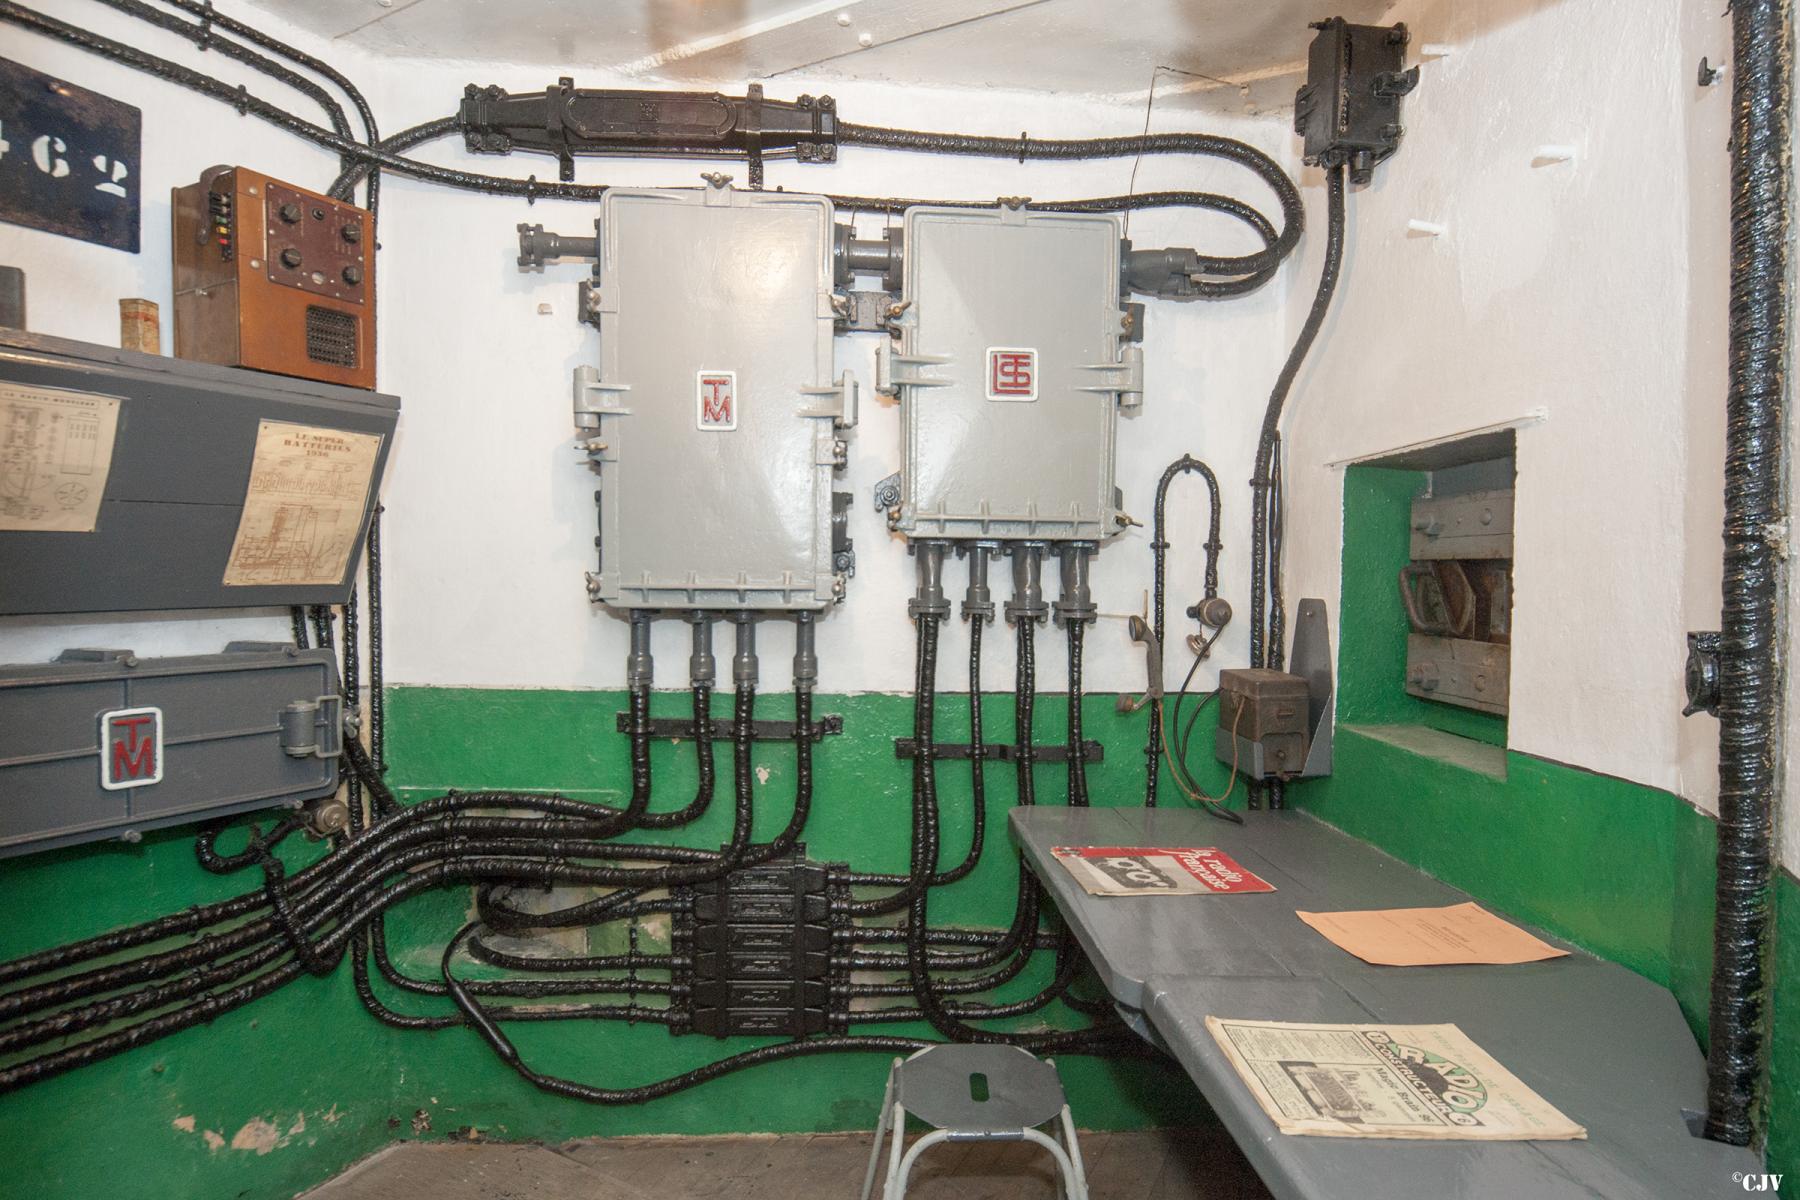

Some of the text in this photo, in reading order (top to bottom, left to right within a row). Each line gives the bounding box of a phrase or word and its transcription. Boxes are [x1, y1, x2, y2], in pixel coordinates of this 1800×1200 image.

[1203, 858, 1242, 883] radio
[1374, 1043, 1450, 1114] CONSTRUCTEUR
[1376, 1067, 1400, 1090] Magic
[1396, 1091, 1420, 1112] Brain
[1397, 1045, 1486, 1110] RADIO
